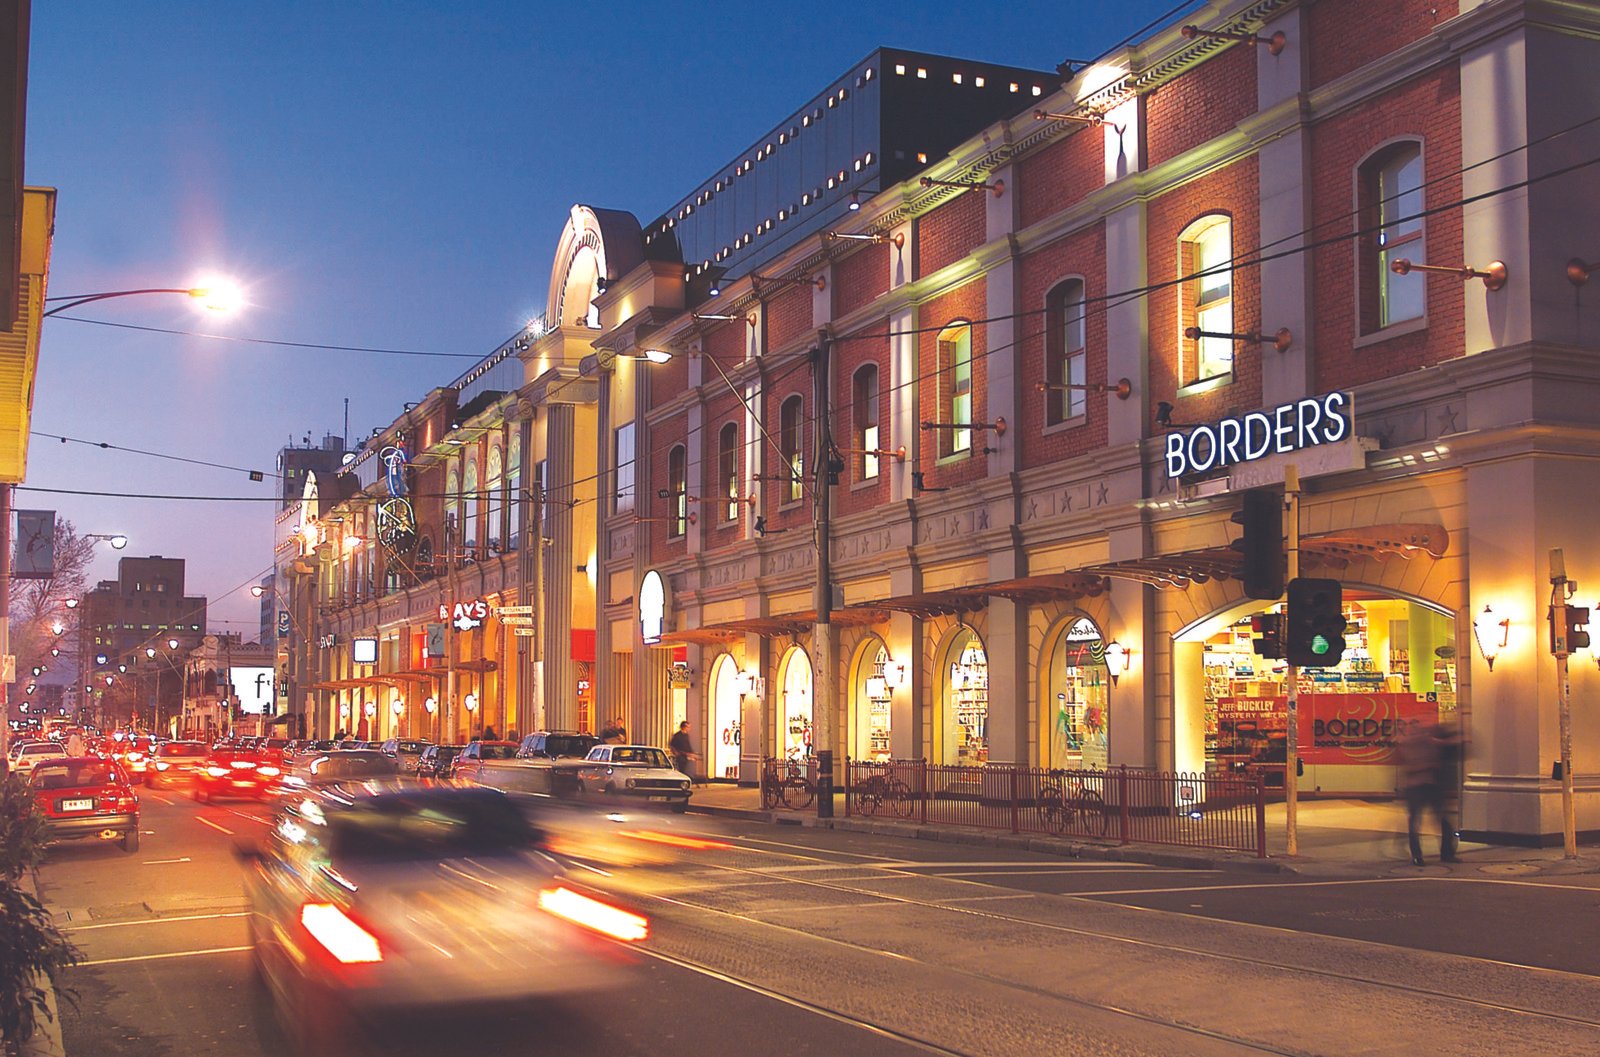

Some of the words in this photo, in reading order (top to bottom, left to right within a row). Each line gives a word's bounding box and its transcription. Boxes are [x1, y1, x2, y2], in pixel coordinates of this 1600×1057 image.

[1166, 392, 1346, 478] BORDERS
[1220, 703, 1235, 712] JEFF
[1237, 700, 1274, 712] BUCKLEY
